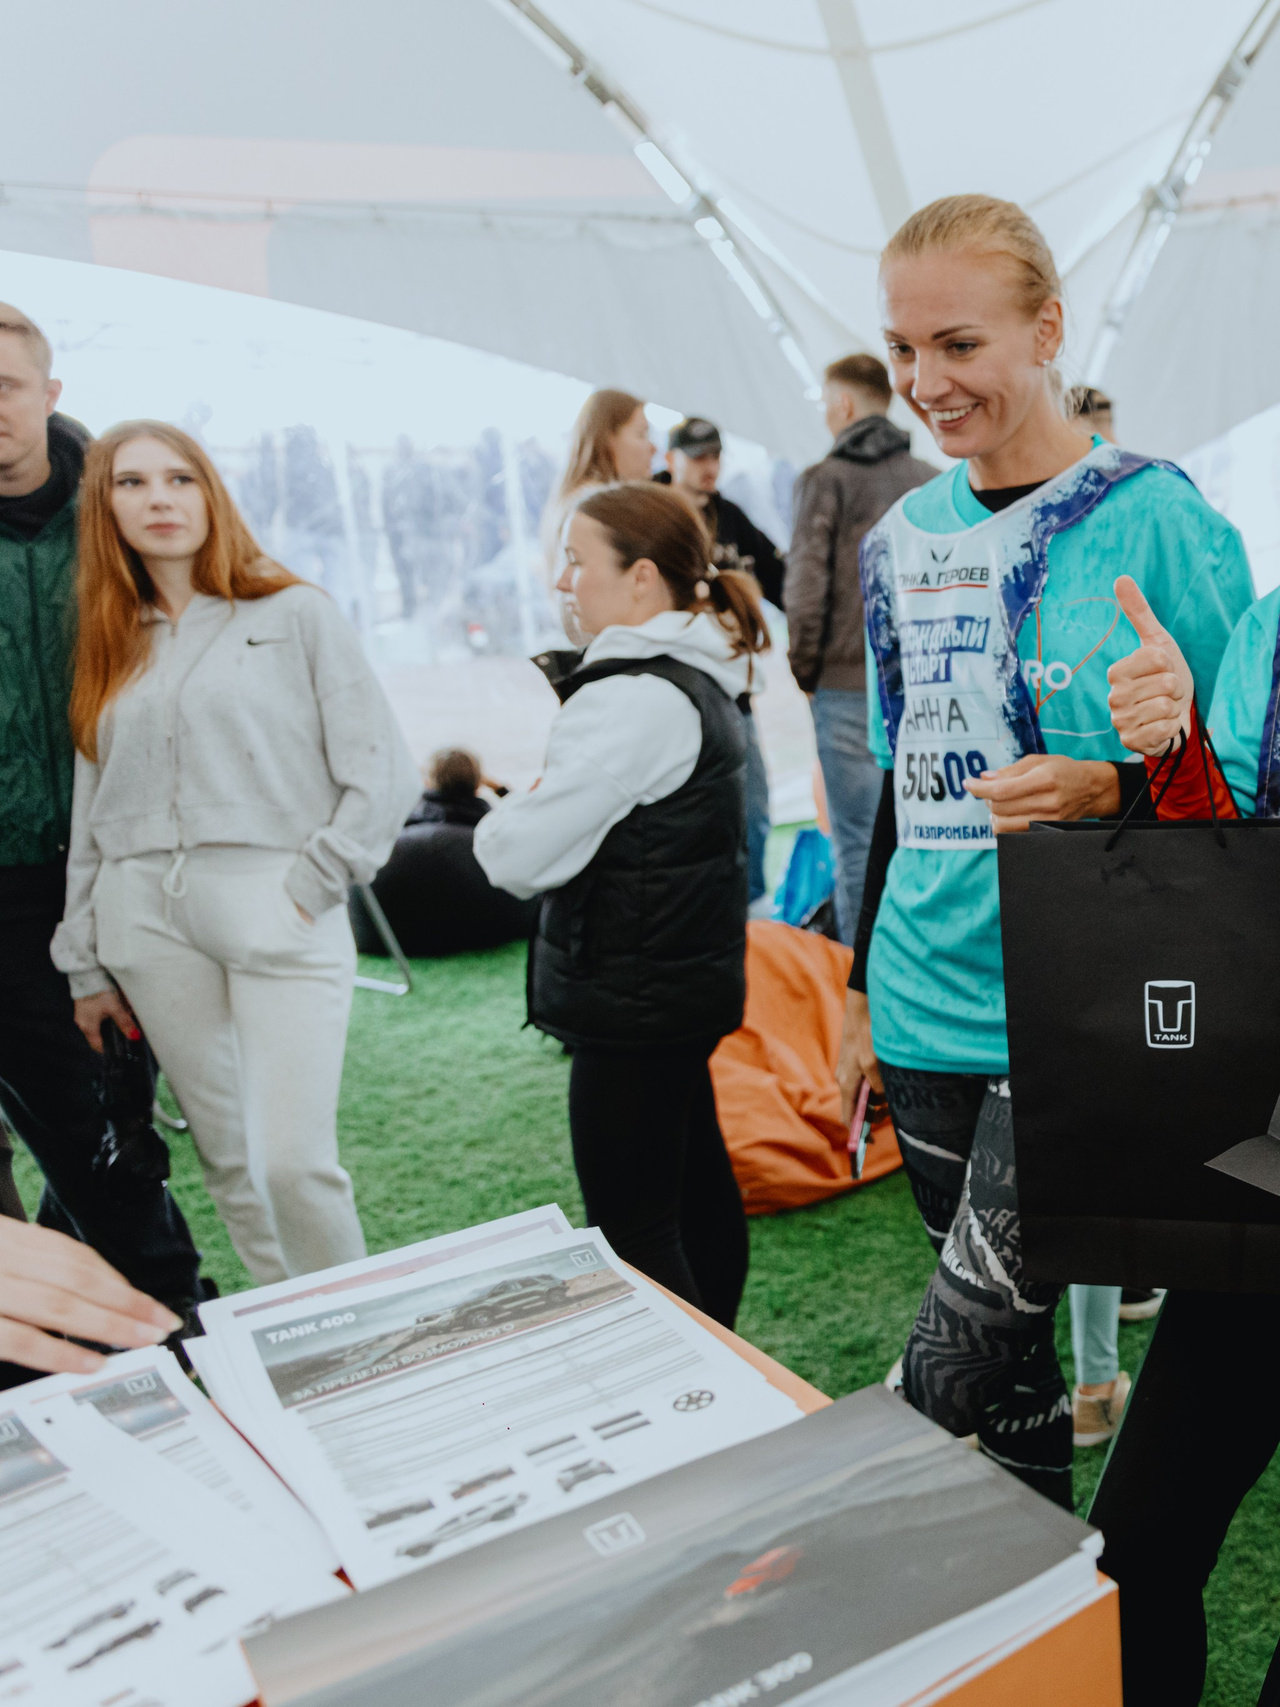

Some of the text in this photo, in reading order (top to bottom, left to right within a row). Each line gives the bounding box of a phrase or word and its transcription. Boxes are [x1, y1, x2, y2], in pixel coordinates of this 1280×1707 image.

[936, 566, 990, 587] ГЕРОЕВ
[905, 698, 969, 734] АННА
[1153, 1033, 1188, 1042] TANK
[265, 1311, 357, 1345] TANK 400
[316, 1359, 399, 1394] ПРЕДЕЛЫ
[399, 1322, 516, 1365] ВОЗМОЖНОГО
